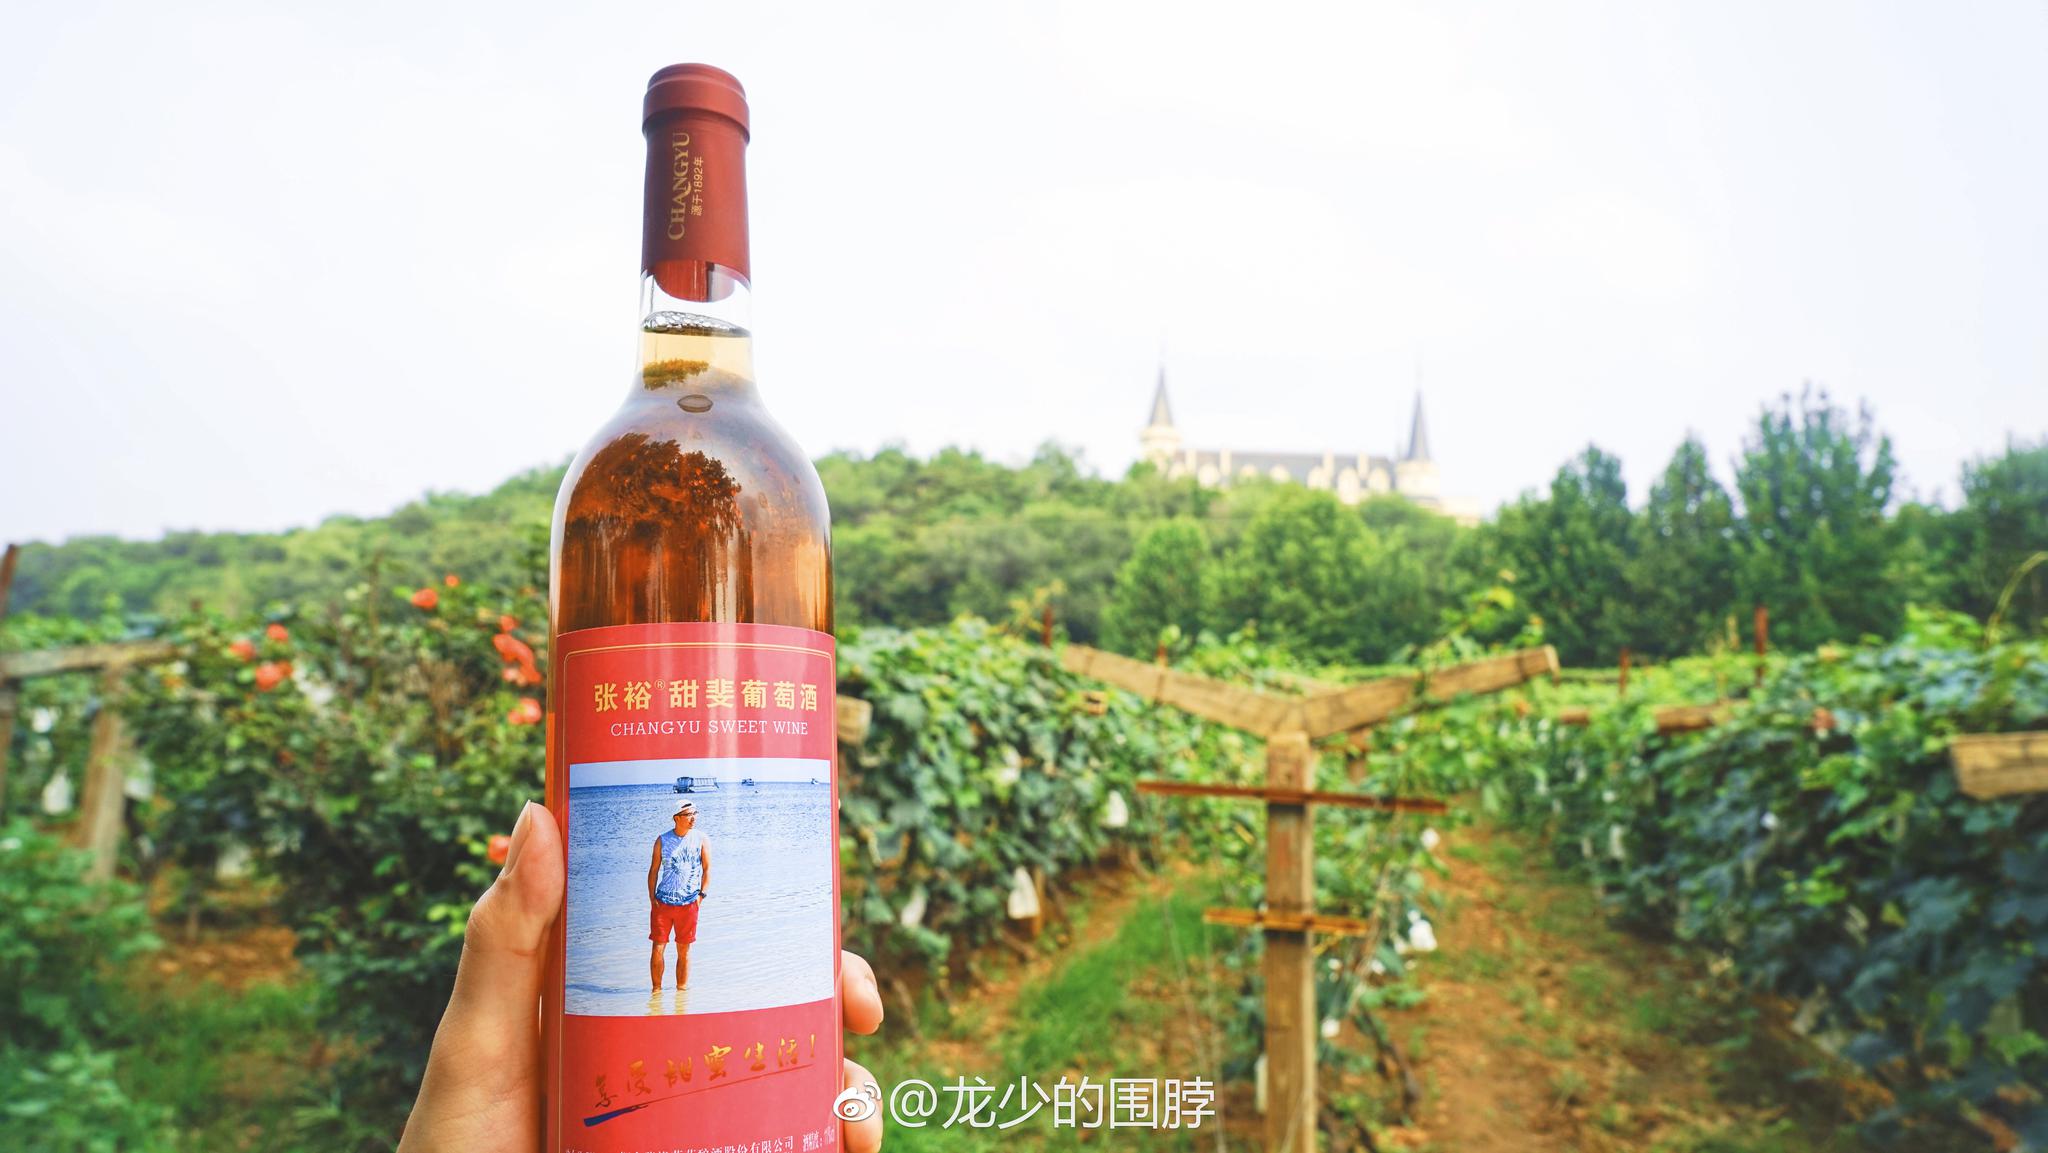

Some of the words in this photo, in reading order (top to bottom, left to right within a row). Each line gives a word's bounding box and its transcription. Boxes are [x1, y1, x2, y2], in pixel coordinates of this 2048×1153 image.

[667, 132, 691, 240] CHANGYU
[690, 157, 704, 216] 源于1892年
[611, 721, 700, 737] CHANGYU
[708, 720, 768, 734] SWEET
[773, 721, 808, 735] WINE
